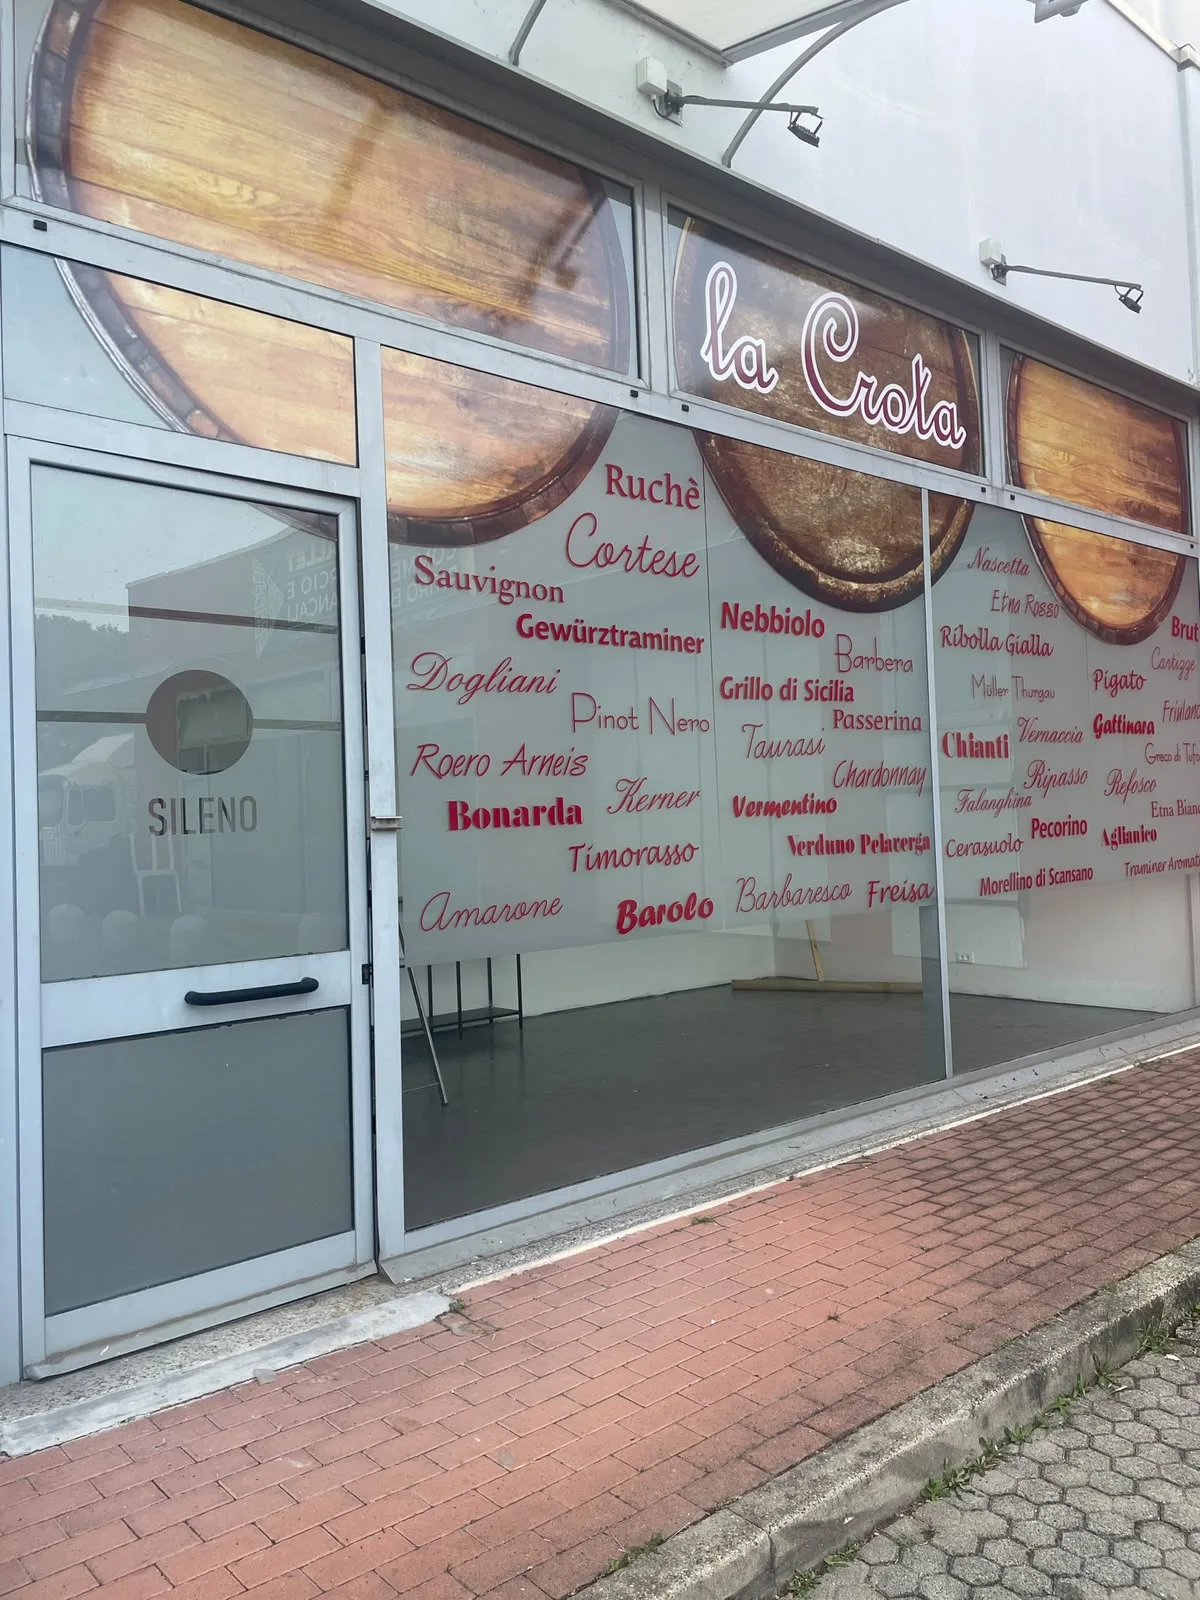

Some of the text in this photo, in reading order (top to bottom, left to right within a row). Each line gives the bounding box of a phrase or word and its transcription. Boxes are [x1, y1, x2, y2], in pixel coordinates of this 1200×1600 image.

[700, 261, 967, 449] la Crota
[605, 463, 701, 510] Ruchè
[564, 512, 700, 578] Cortese
[967, 546, 1031, 577] Nascetta
[414, 554, 565, 605] Sauvignon
[991, 589, 1060, 618] Etna Rosso
[516, 612, 705, 655] Gewürztraminer
[720, 601, 826, 639] Nebbiolo
[1171, 615, 1199, 642] Brut
[834, 633, 914, 674] Barbera
[939, 624, 1055, 657] Ribolla Gialla
[407, 651, 561, 706] Dogliani
[720, 675, 855, 703] Grillo di Sicilia
[971, 673, 1056, 703] Müller Thurgau
[1093, 668, 1148, 698] Pigato
[571, 691, 711, 737] Pinot Nero
[832, 708, 923, 732] Passerina
[1093, 712, 1155, 740] Gattinara
[741, 722, 826, 760] Taurasi
[941, 731, 1009, 759] Chianti
[1017, 716, 1085, 745] Vernaccia
[410, 743, 590, 780] Roero Arneis
[1144, 742, 1173, 765] Greco
[833, 760, 927, 797] Chardonnay
[1023, 759, 1089, 800] Ripasso
[1103, 767, 1158, 804] Refosco
[606, 776, 702, 816] Kerner
[731, 792, 838, 819] Vermentino
[955, 787, 1033, 818] Falanghina
[1151, 800, 1175, 818] Etna
[147, 795, 258, 837] SILENO
[447, 796, 584, 832] Bonarda
[1031, 815, 1089, 840] Pecorino
[787, 832, 931, 857] Verduno Pelaverga
[945, 832, 1024, 859] Cerasuolo
[1102, 824, 1158, 851] Aglianico
[567, 841, 700, 873] Timorasso
[1124, 859, 1167, 878] Traminer
[735, 872, 853, 913] Barbaresco
[867, 878, 935, 908] Freisa
[979, 866, 1094, 897] Morellino di Scansano
[419, 890, 563, 933] Amarone
[615, 891, 715, 936] Barolo
